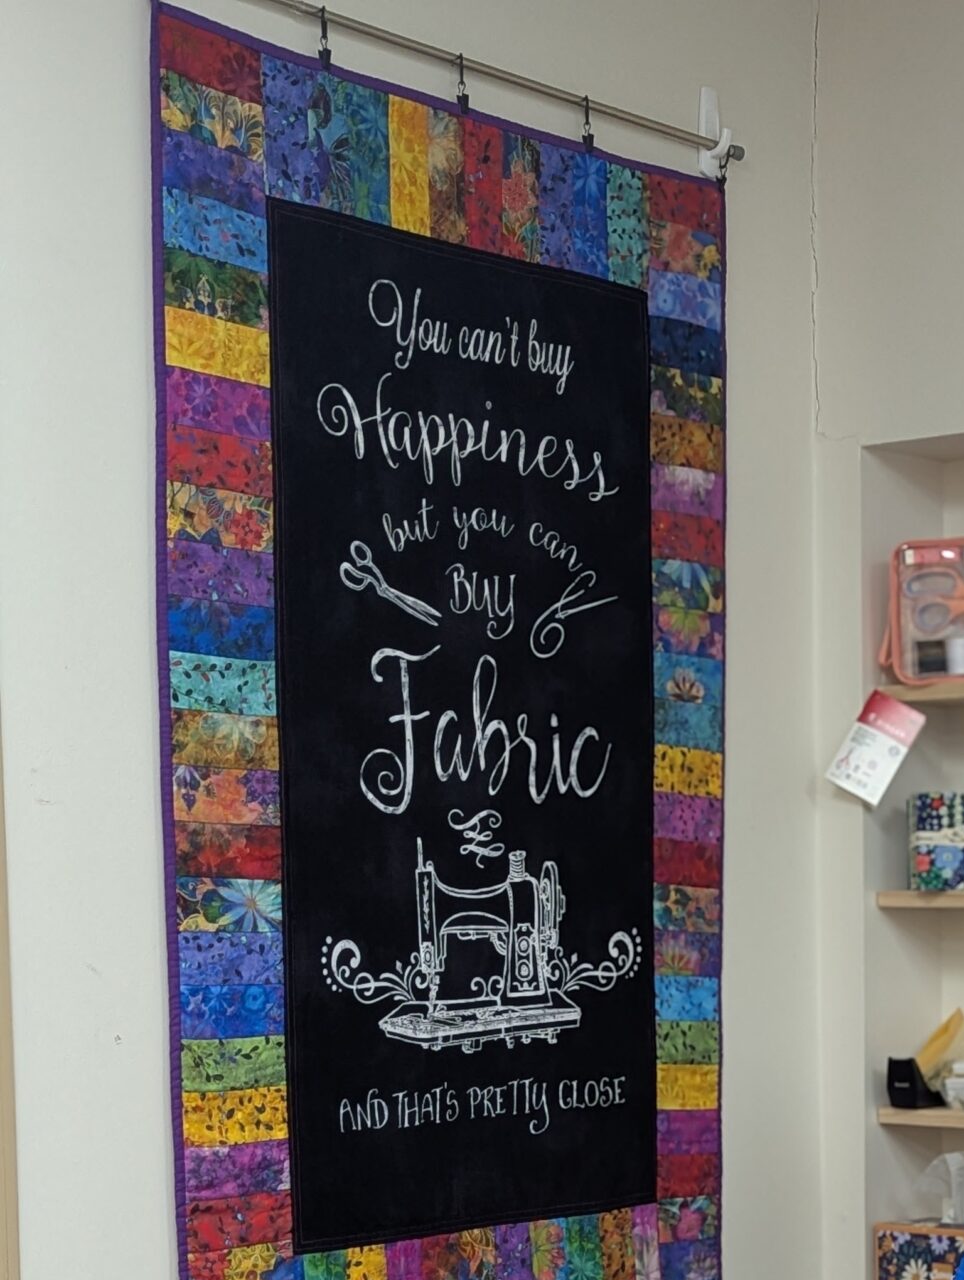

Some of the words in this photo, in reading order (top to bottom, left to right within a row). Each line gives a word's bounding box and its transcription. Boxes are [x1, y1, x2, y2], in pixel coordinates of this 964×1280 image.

[369, 280, 451, 369] You
[459, 317, 520, 367] can't
[528, 319, 574, 395] buy
[317, 372, 619, 501] Happiness
[382, 498, 439, 552] but
[453, 506, 514, 550] you
[529, 522, 583, 572] can
[360, 644, 612, 815] Fabric
[339, 1088, 388, 1133] AND
[392, 1081, 459, 1128] THAT'S
[467, 1077, 548, 1134] PRETTY
[559, 1076, 626, 1109] CLOSE
